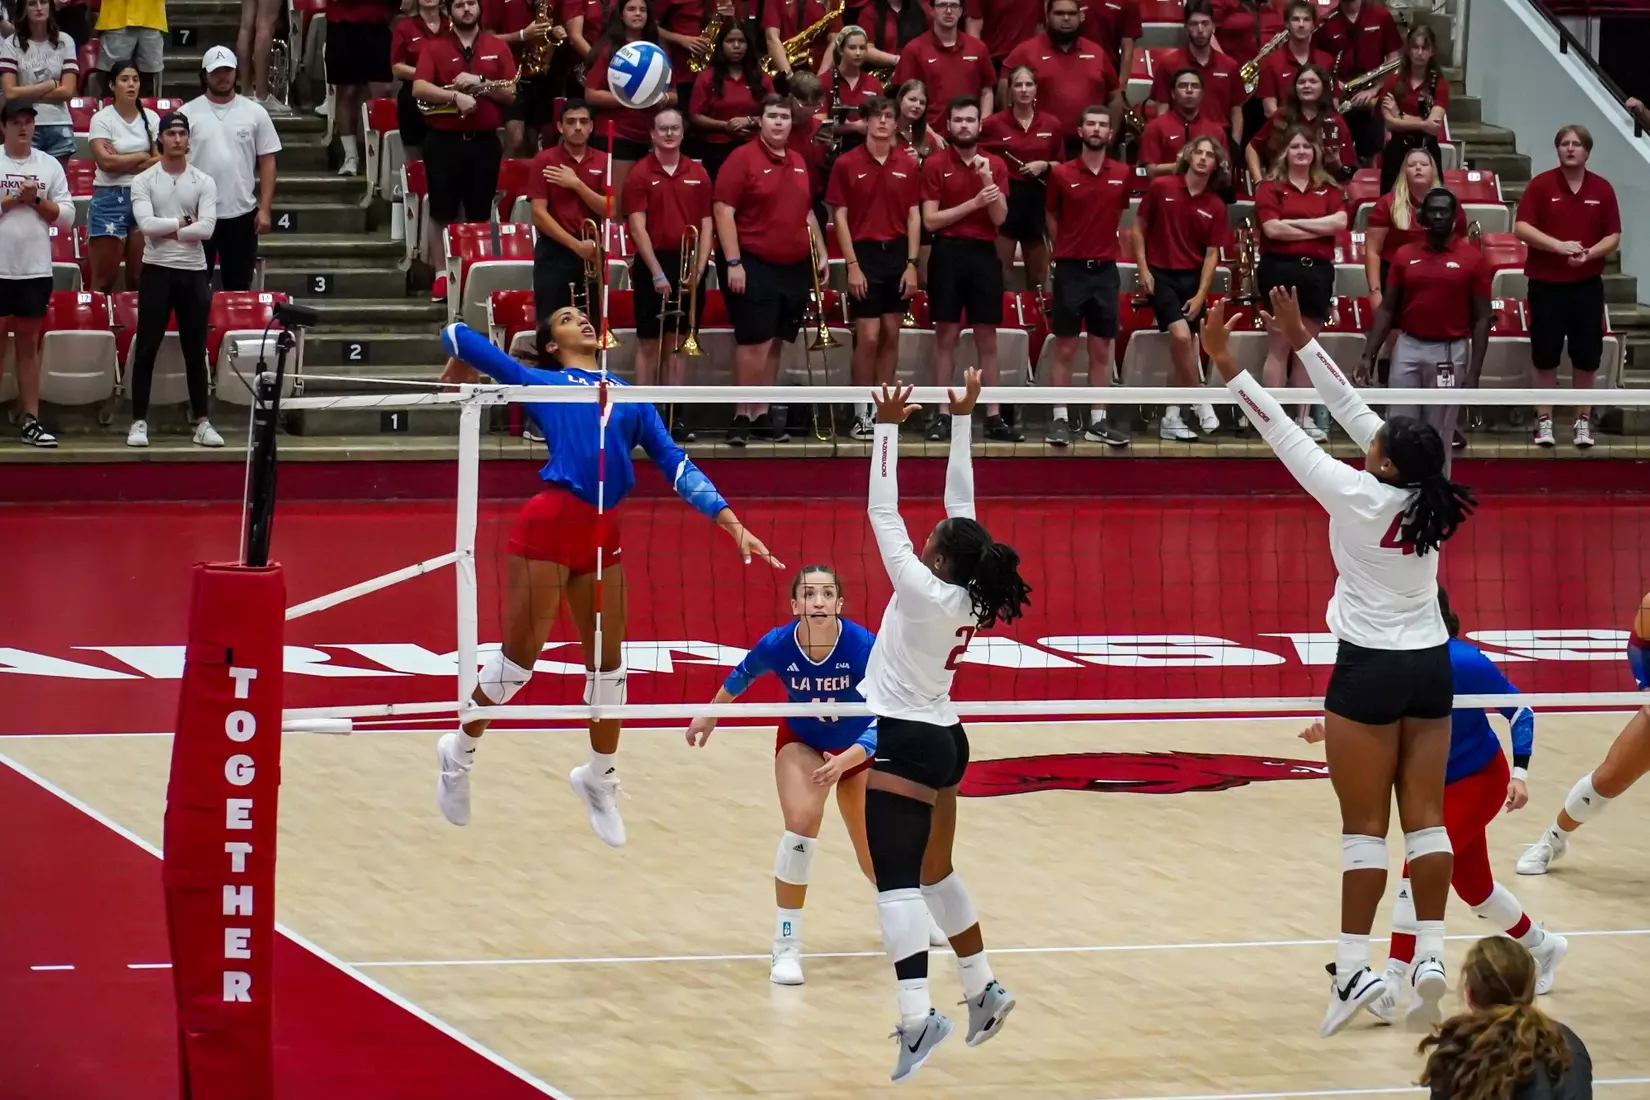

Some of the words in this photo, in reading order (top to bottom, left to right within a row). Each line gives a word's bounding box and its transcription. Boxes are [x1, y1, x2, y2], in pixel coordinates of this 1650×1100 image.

[179, 29, 190, 45] 7
[216, 50, 226, 60] A
[277, 213, 290, 229] 4
[314, 276, 326, 292] 3
[349, 344, 362, 360] 2
[391, 413, 398, 430] 1
[791, 676, 811, 691] LA
[815, 675, 850, 691] TECH
[222, 666, 258, 1003] TOGETHER
